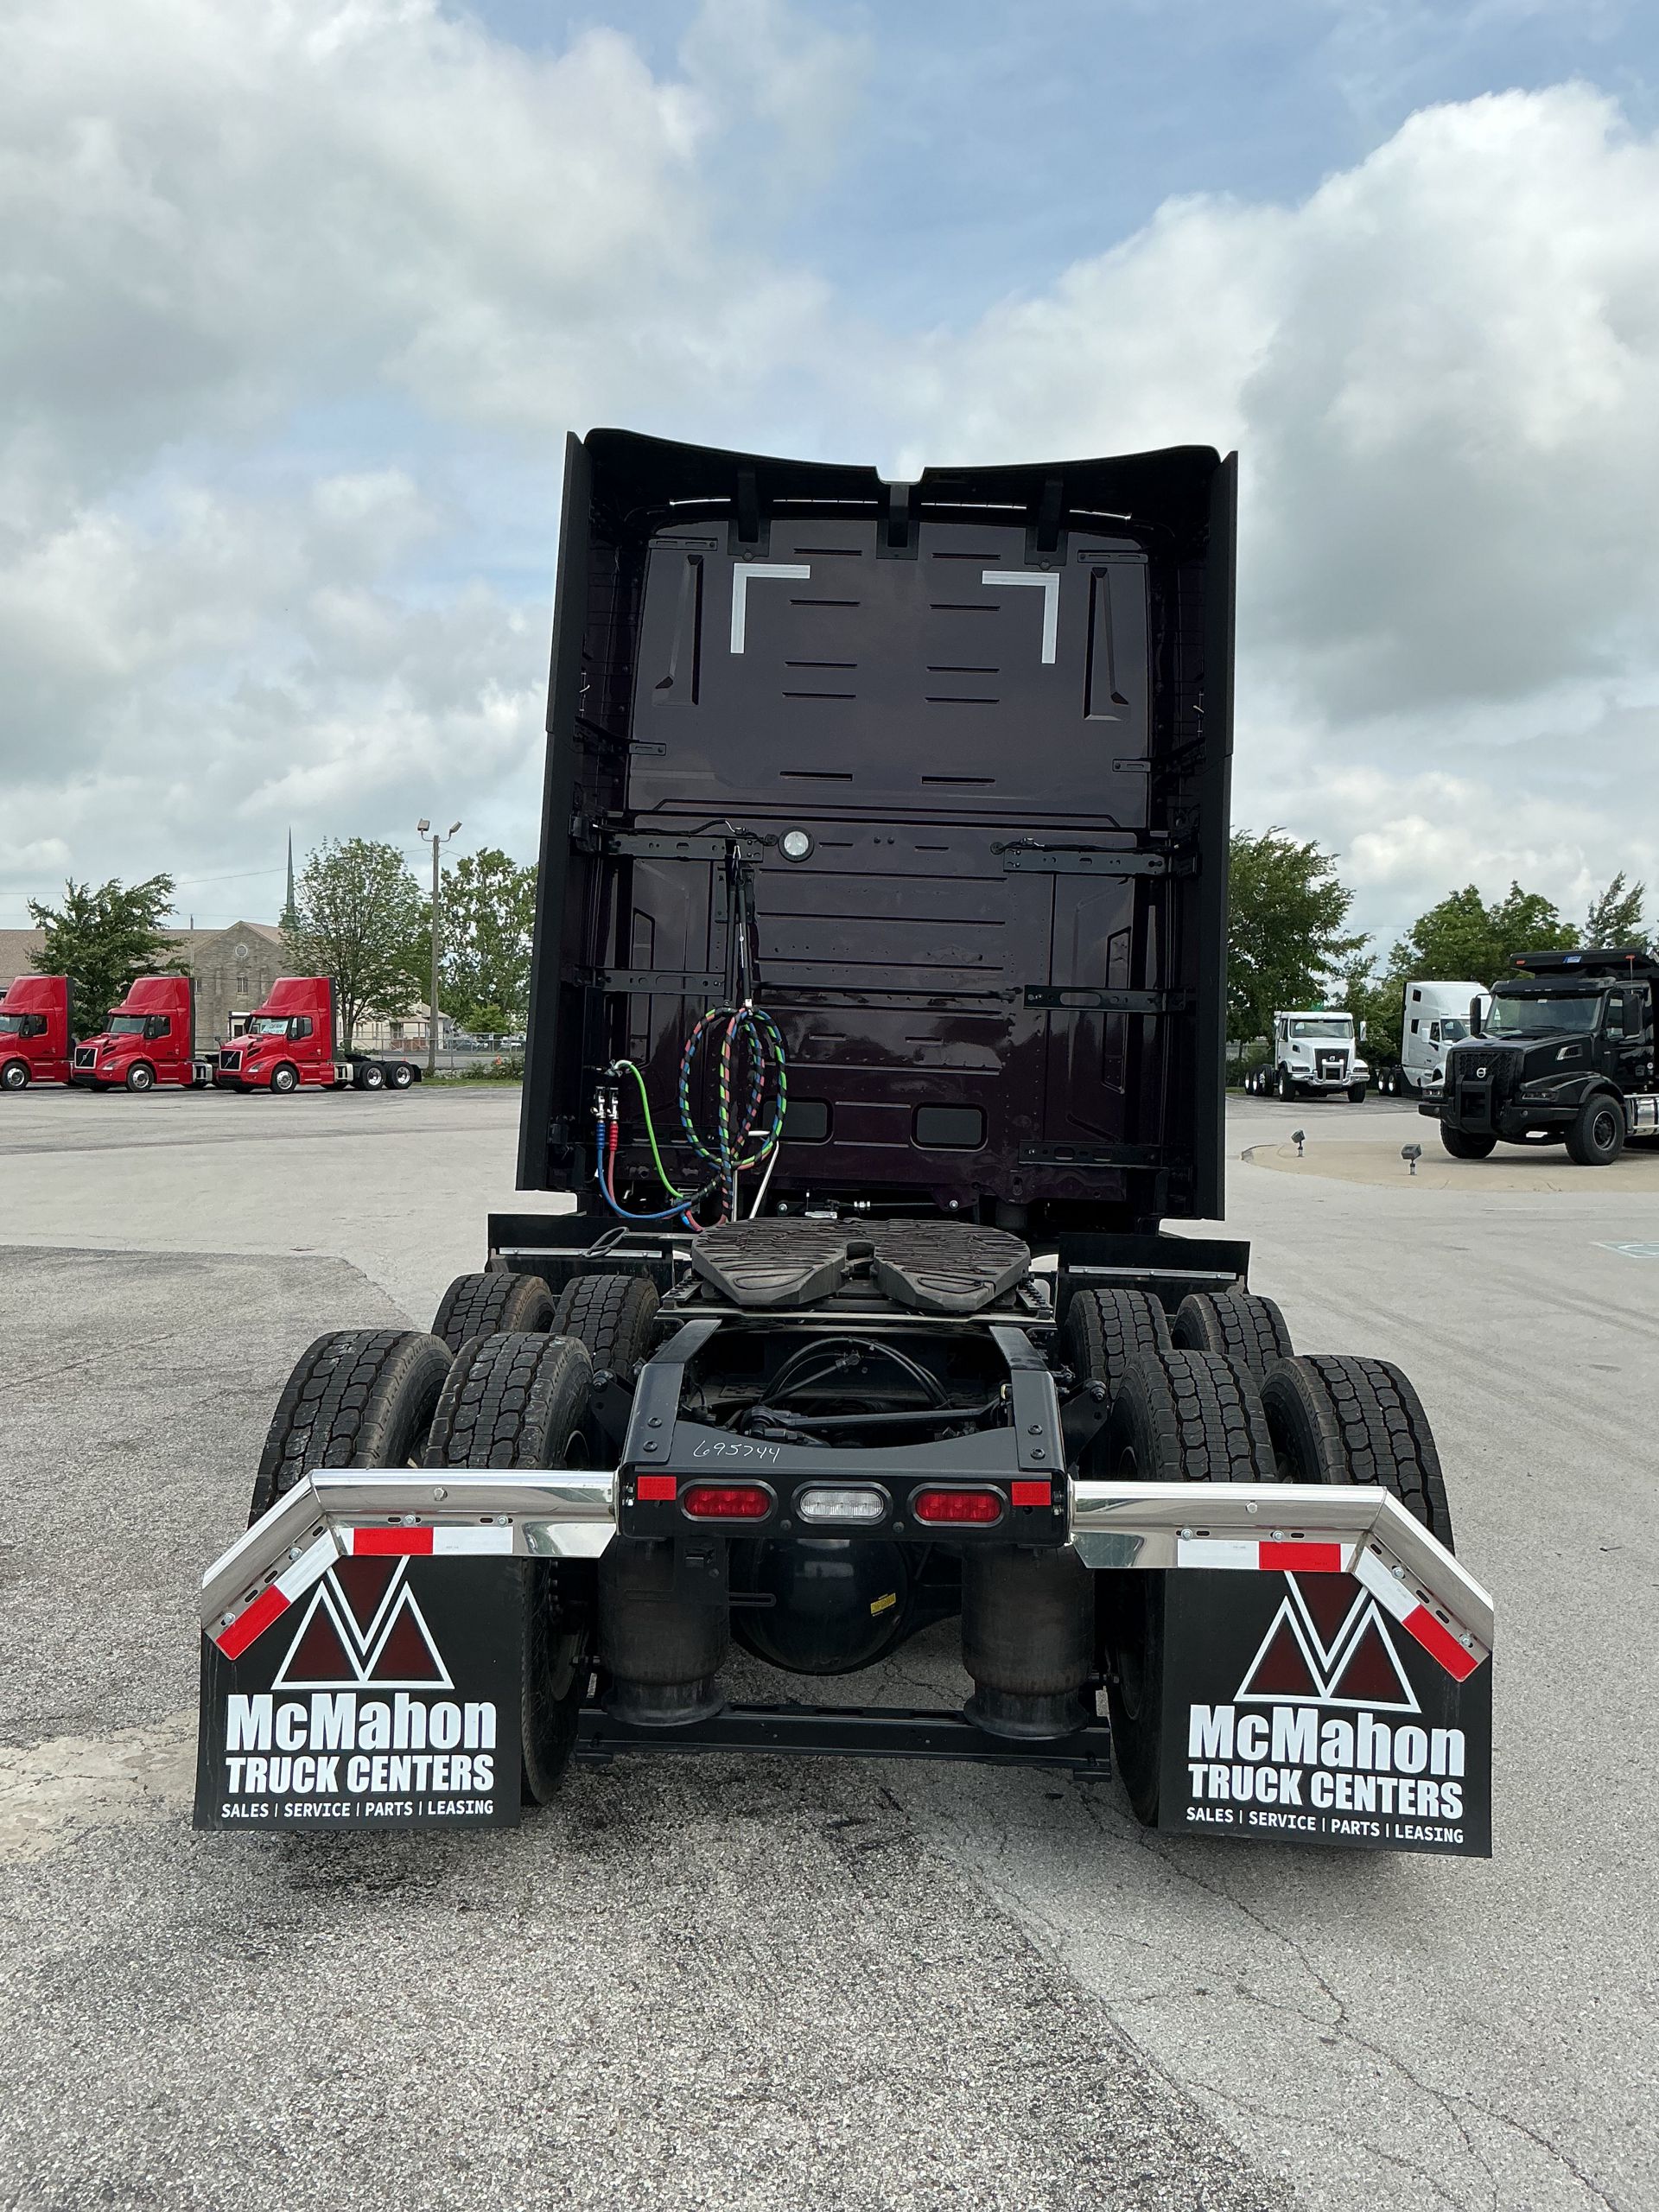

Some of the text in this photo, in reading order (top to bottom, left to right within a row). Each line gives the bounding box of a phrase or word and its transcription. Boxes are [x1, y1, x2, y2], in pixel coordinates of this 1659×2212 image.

[693, 1440, 780, 1464] 695744
[226, 1692, 497, 1751] McMahon
[1188, 1704, 1465, 1777] McMahon
[225, 1753, 494, 1794] TRUCK CENTERS
[1187, 1763, 1464, 1820] TRUCK CENTERS
[220, 1802, 270, 1819] SALES
[283, 1802, 352, 1818] SERVICE
[365, 1801, 413, 1817] PARTS
[427, 1799, 494, 1815] LEASING
[1185, 1806, 1234, 1823] SALES
[1248, 1810, 1317, 1831] SERVICE
[1331, 1818, 1381, 1837] PARTS
[1395, 1823, 1464, 1844] LEASING
